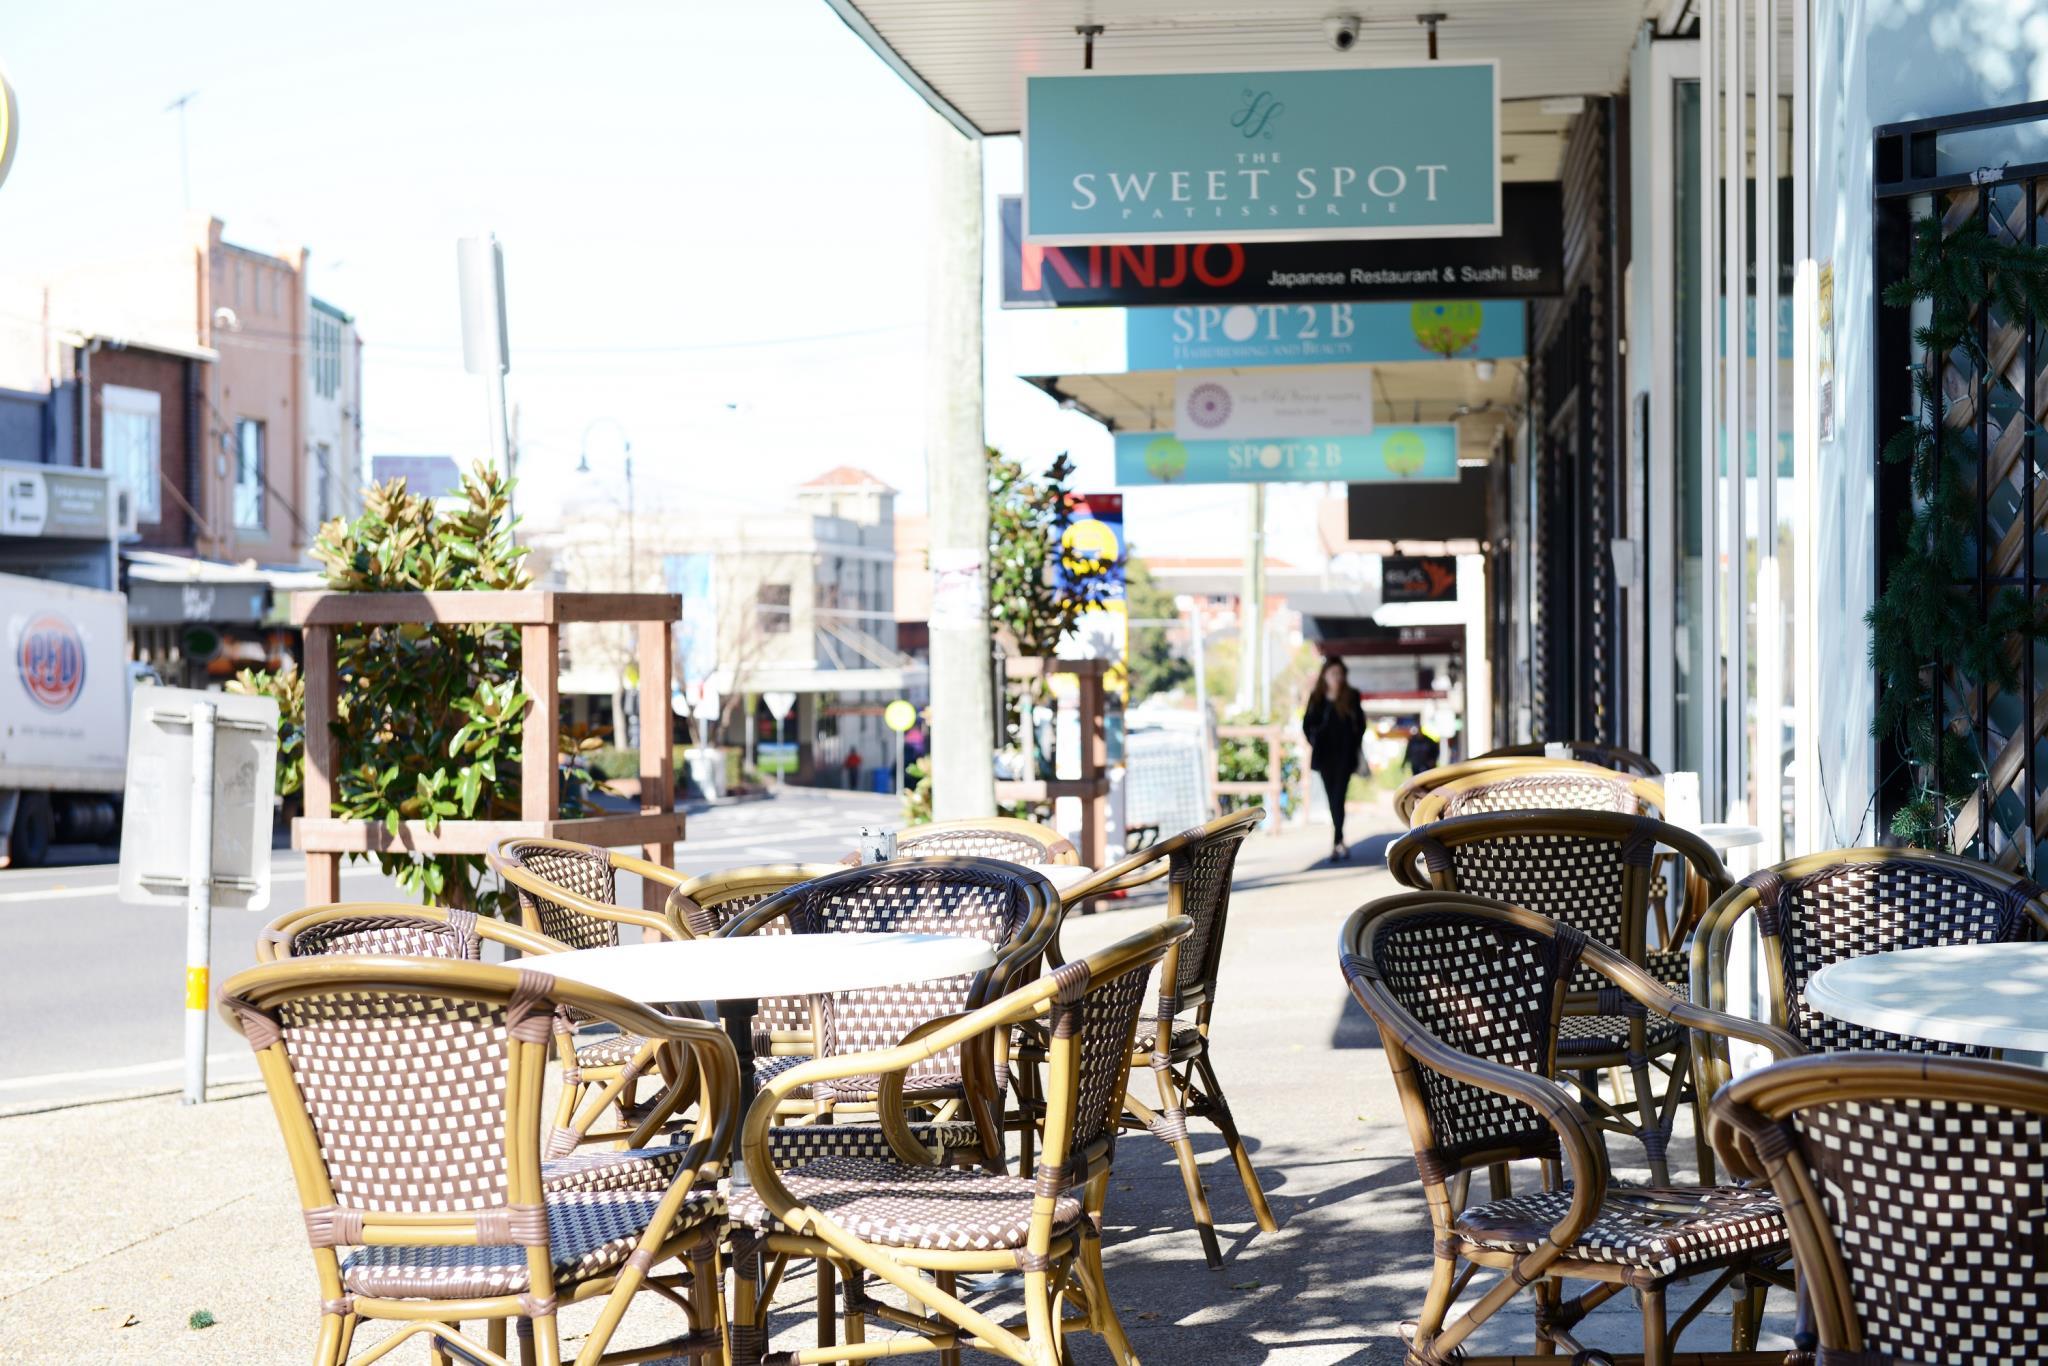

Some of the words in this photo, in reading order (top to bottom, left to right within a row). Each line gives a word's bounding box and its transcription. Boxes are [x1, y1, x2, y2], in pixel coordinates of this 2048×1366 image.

[1235, 152, 1281, 164] THE
[1071, 169, 1270, 210] SWEET
[1295, 165, 1448, 201] SPOT
[1121, 202, 1397, 219] PATISSERIE
[1267, 270, 1346, 288] Japanese
[1350, 267, 1438, 284] Restaurant
[1443, 266, 1455, 282] &
[1460, 265, 1507, 282] Sushi
[1511, 264, 1542, 281] Bar
